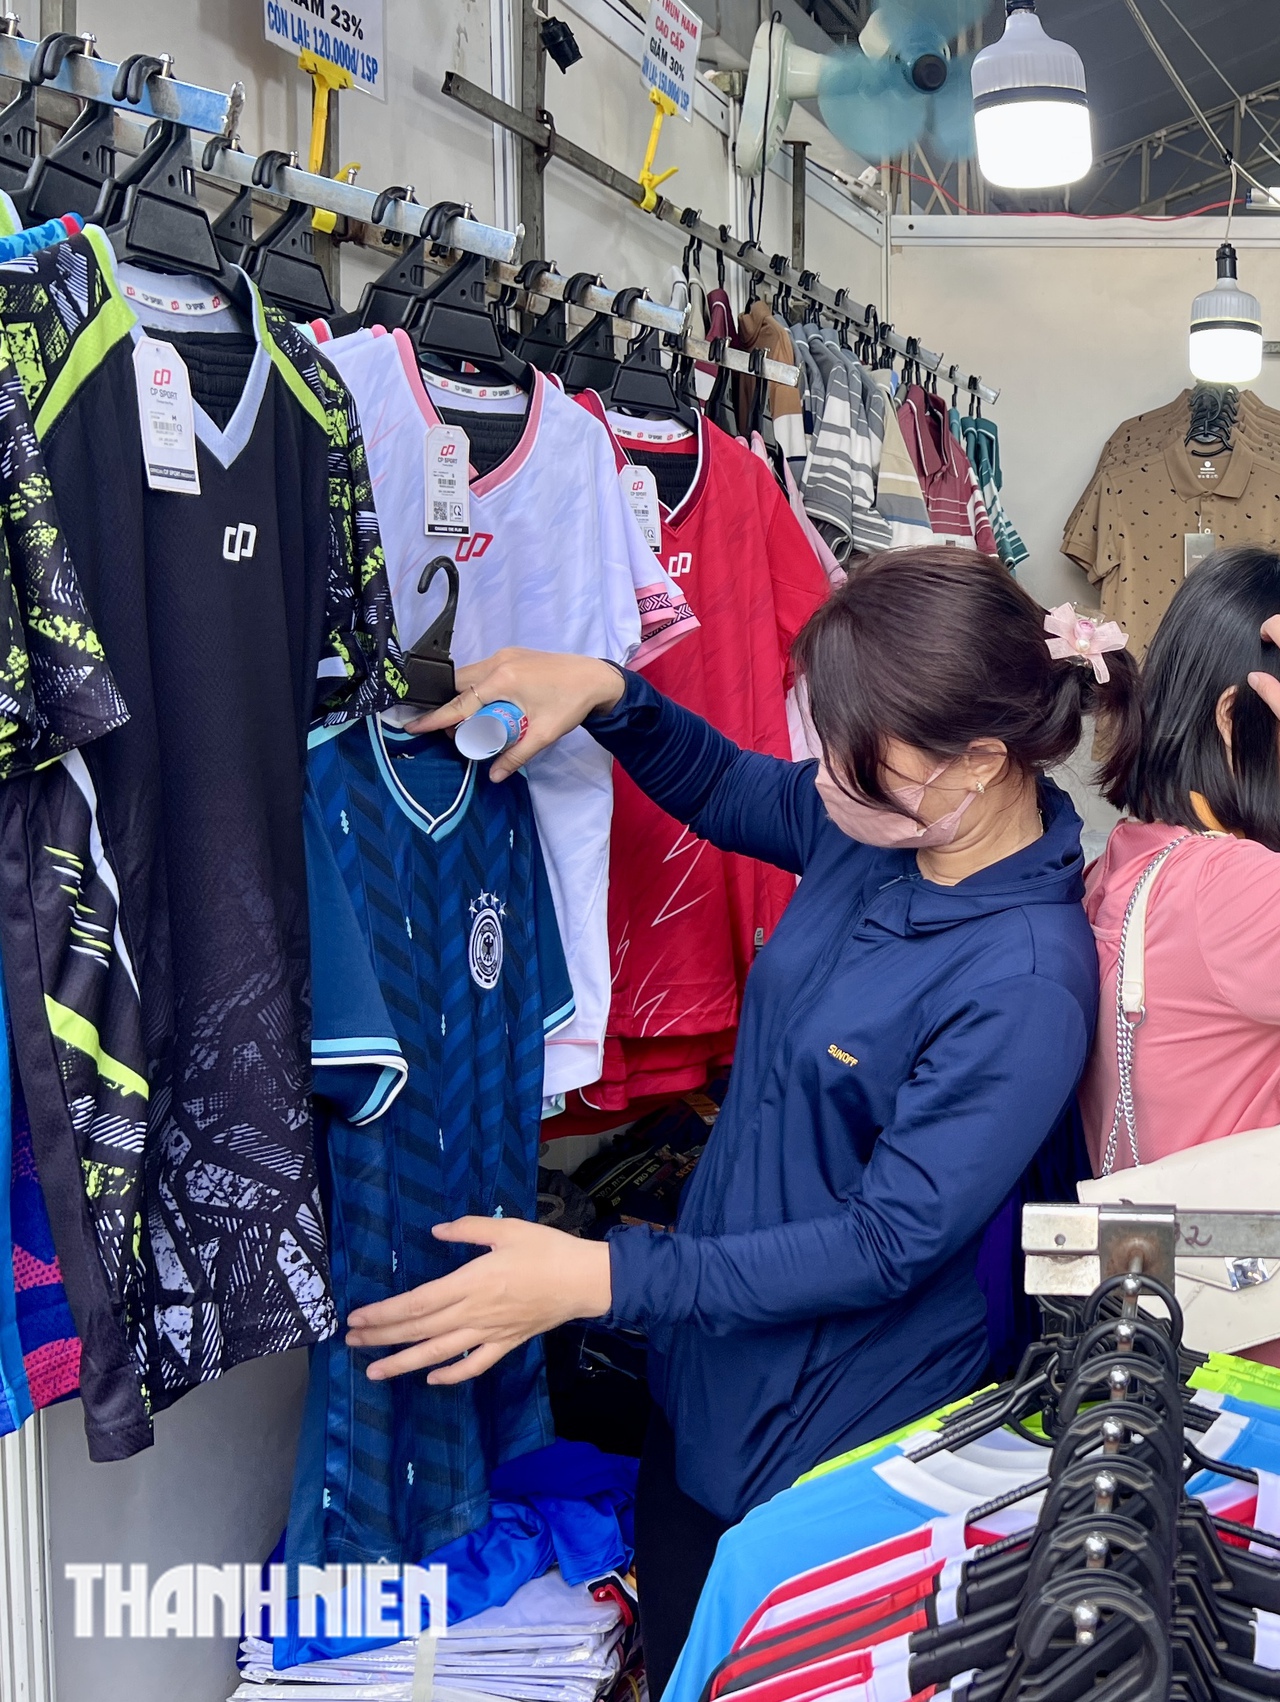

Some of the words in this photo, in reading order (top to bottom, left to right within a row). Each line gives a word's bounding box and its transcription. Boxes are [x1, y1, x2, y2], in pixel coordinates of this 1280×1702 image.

[331, 4, 364, 40] 23%
[655, 16, 669, 39] CAO
[670, 31, 685, 52] CẤP
[681, 14, 698, 39] NAM
[650, 37, 668, 66] GIẢM
[669, 56, 685, 81] 30%
[150, 387, 158, 397] CP
[159, 388, 178, 400] SPORT
[828, 1044, 859, 1067] SUNOFF
